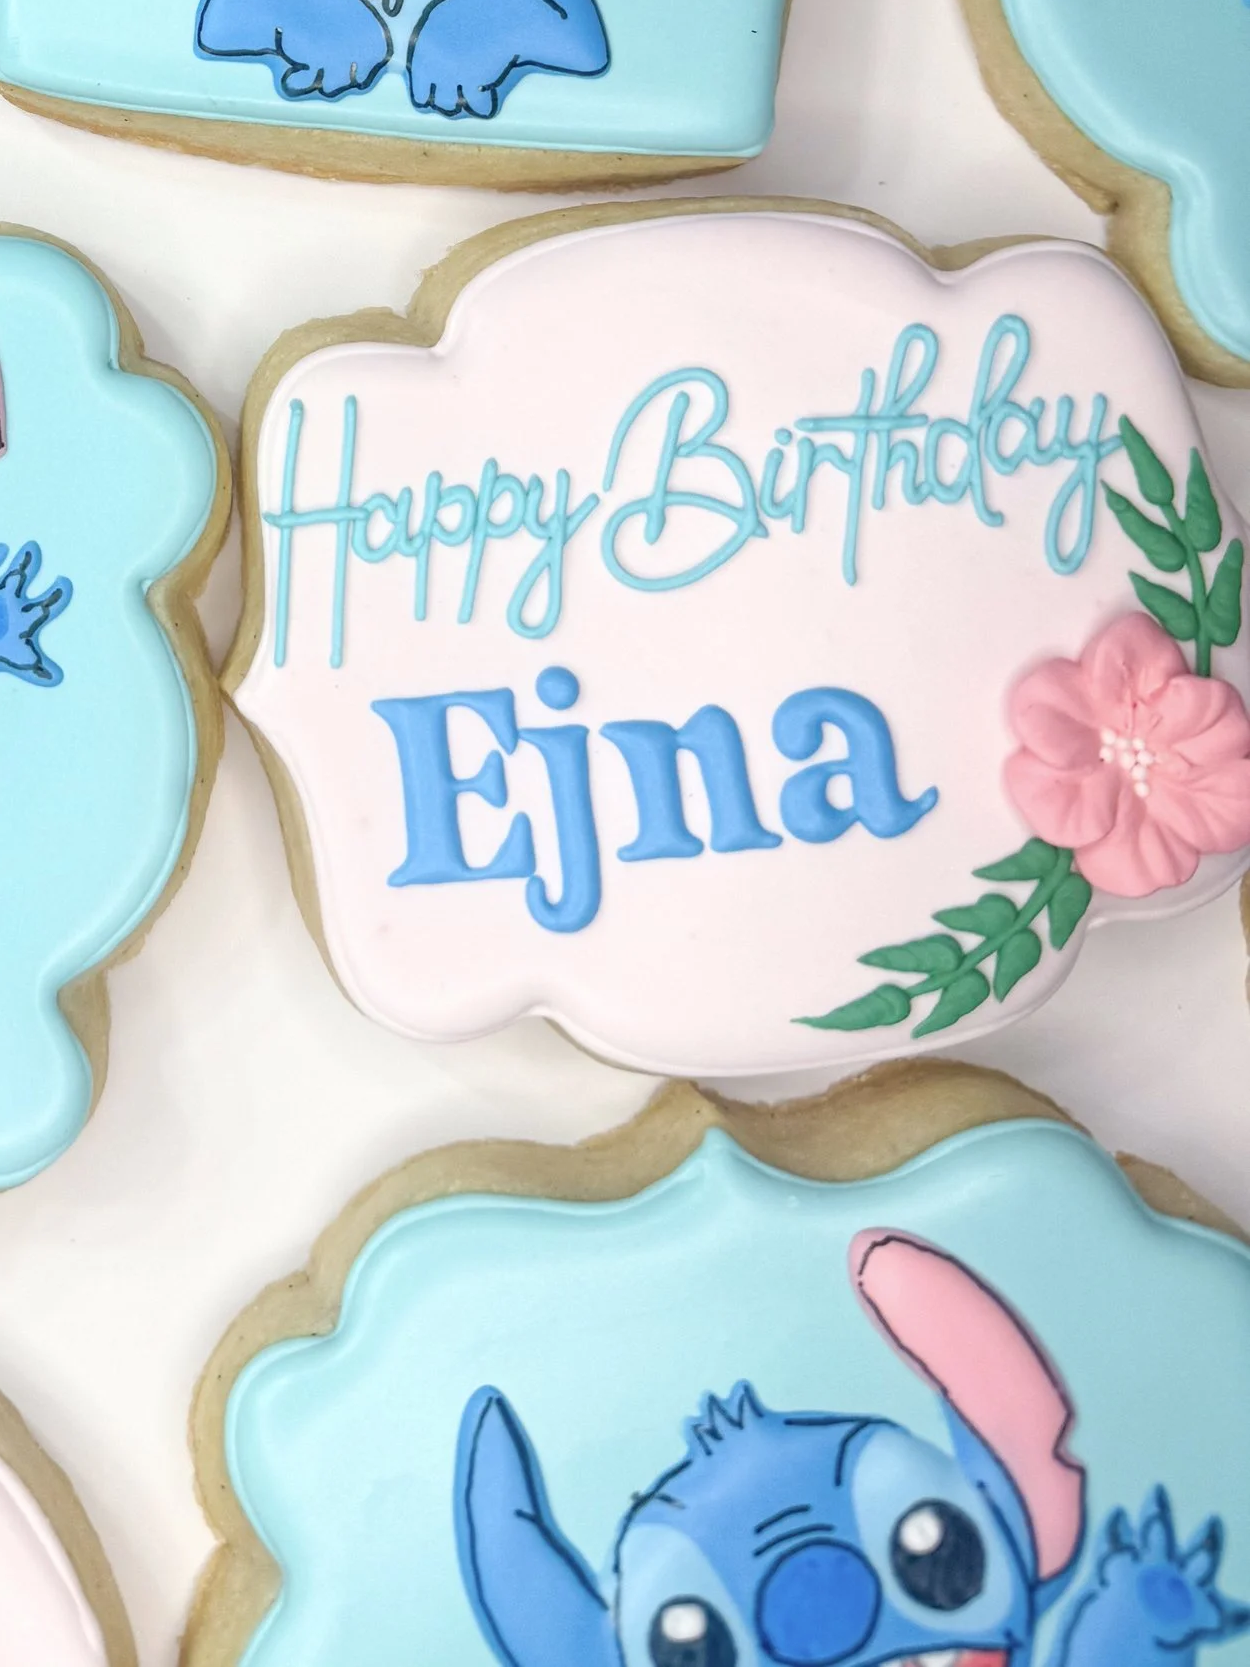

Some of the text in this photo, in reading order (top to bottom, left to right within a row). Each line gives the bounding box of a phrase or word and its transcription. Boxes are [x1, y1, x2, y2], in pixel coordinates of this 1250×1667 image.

[263, 316, 1122, 668] Happy Birthday
[372, 666, 938, 933] Ejna
